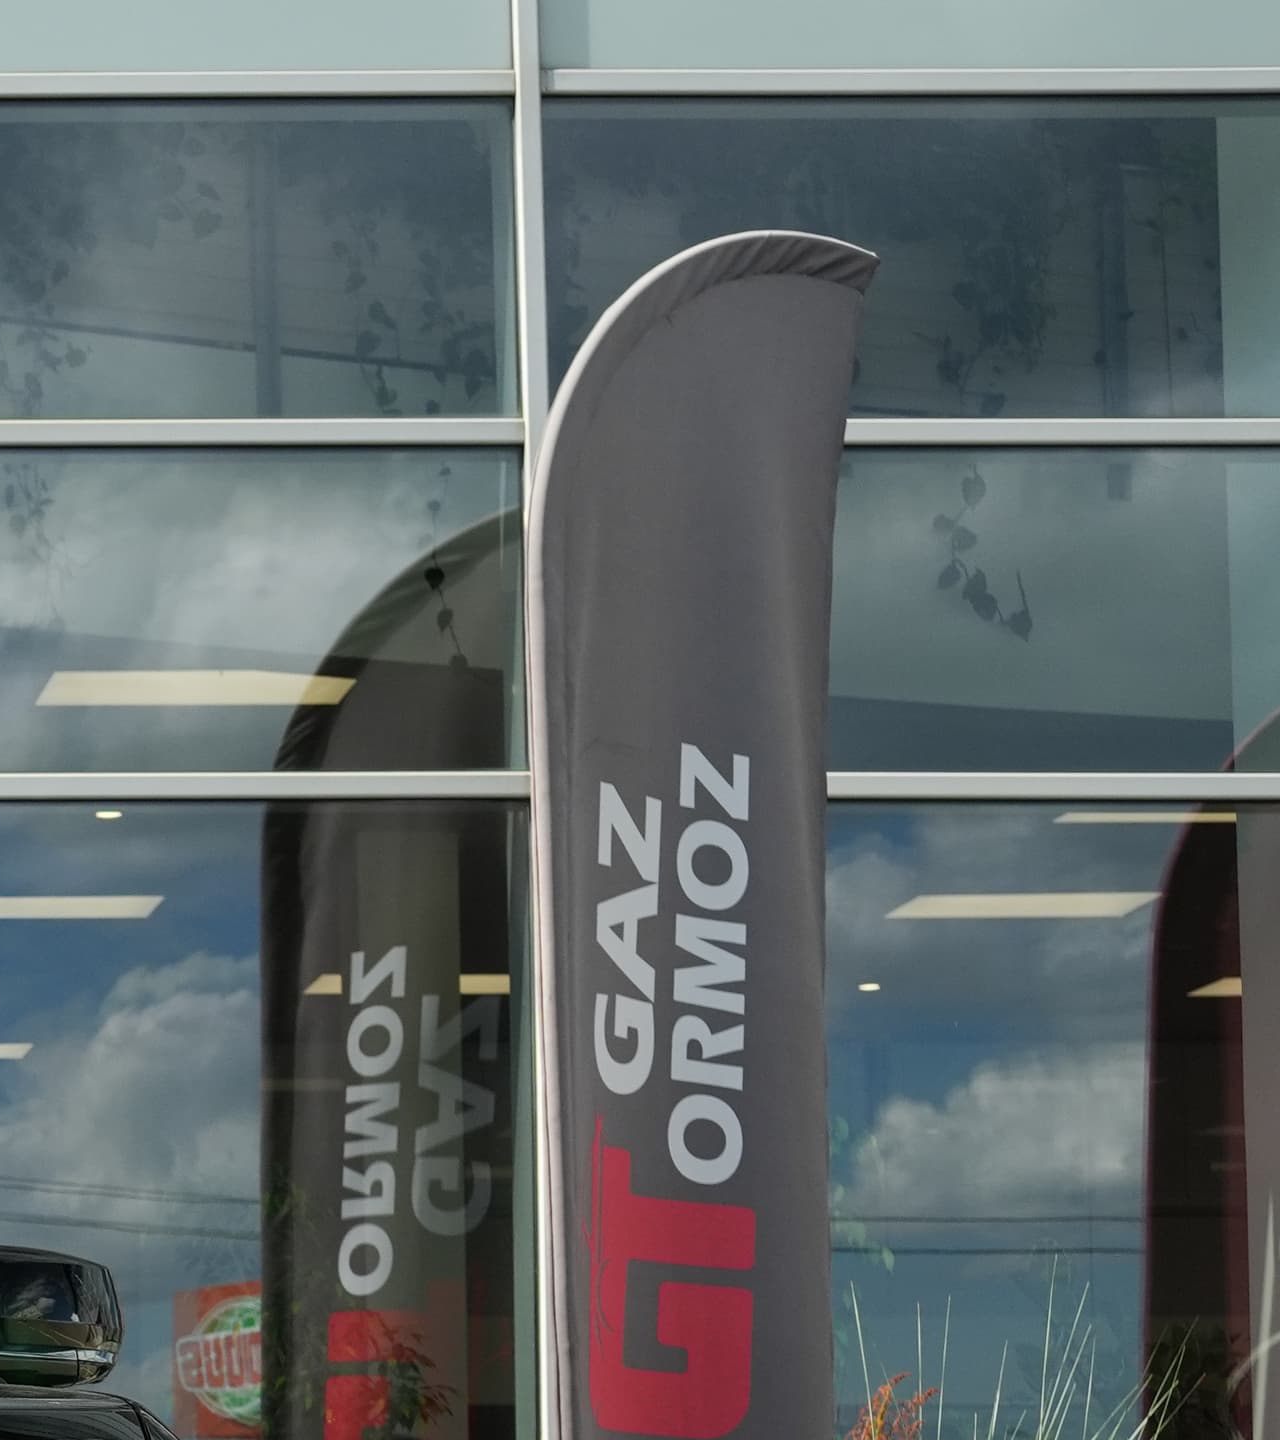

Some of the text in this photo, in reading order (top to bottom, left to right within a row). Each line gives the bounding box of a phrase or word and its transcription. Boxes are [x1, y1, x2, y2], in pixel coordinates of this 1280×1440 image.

[593, 780, 662, 1095] GAZ
[667, 742, 750, 1184] ORMOZ
[583, 1113, 756, 1440] GT
